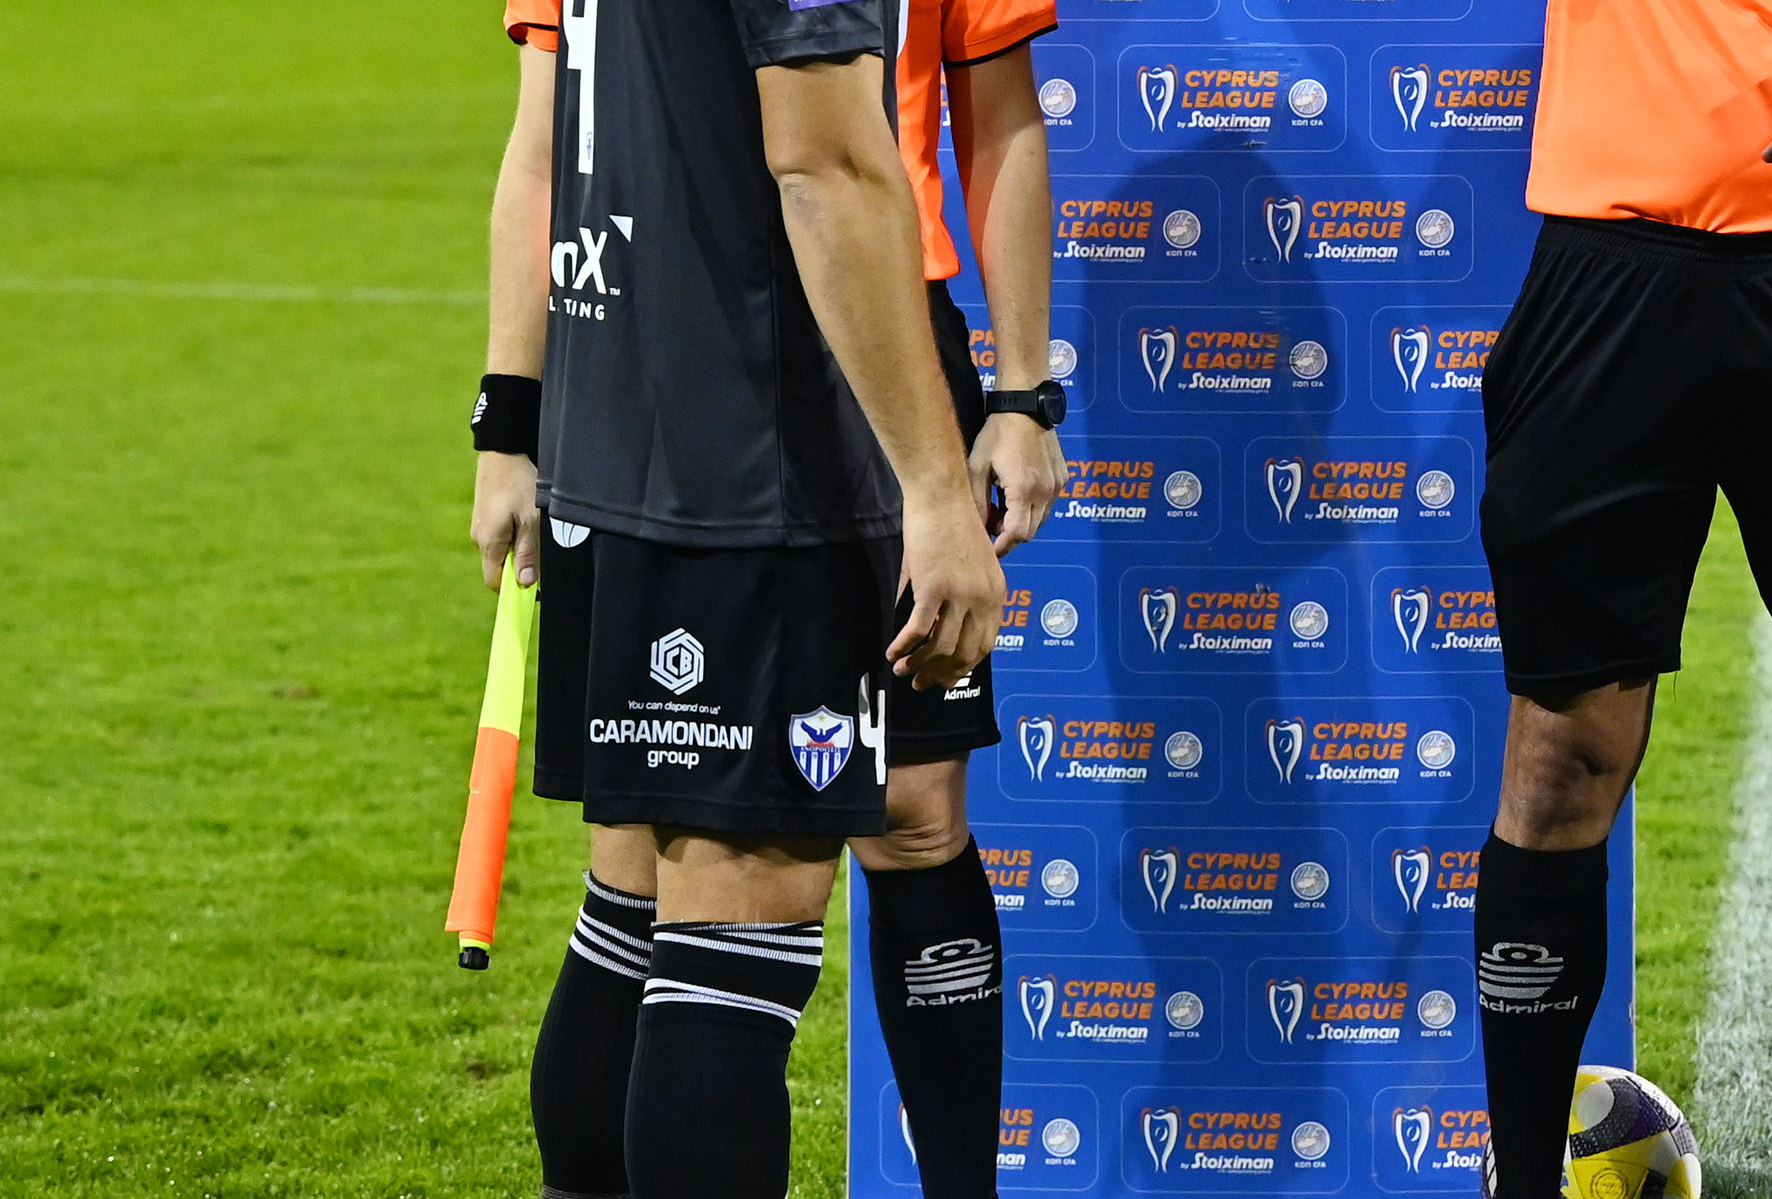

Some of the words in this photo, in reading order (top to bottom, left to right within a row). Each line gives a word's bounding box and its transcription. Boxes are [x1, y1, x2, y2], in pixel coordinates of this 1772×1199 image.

[1186, 71, 1278, 87] CYPRUS
[1439, 70, 1532, 86] CYPRUS
[1182, 91, 1276, 107] LEAGUE
[1436, 91, 1528, 107] LEAGUE
[1187, 111, 1271, 128] Stoiximan
[1441, 111, 1523, 128] Stoiximan
[1062, 201, 1153, 217] CYPRUS
[1312, 201, 1406, 217] CYPRUS
[1058, 222, 1151, 238] LEAGUE
[1309, 222, 1403, 238] LEAGUE
[1063, 241, 1145, 258] Stoiximan
[1314, 242, 1398, 259] Stoiximan
[1187, 332, 1279, 348] CYPRUS
[1183, 353, 1276, 369] LEAGUE
[1188, 373, 1272, 390] Stoiximan
[1065, 461, 1154, 478] CYPRUS
[1314, 462, 1407, 478] CYPRUS
[1061, 482, 1152, 498] LEAGUE
[1310, 483, 1404, 499] LEAGUE
[1065, 501, 1147, 518] Stoiximan
[1315, 503, 1399, 520] Stoiximan
[1187, 593, 1280, 609] CYPRUS
[1184, 613, 1277, 630] LEAGUE
[1189, 633, 1273, 650] Stoiximan
[943, 685, 981, 701] Admiral
[628, 700, 643, 710] You
[646, 702, 662, 710] can
[665, 701, 697, 713] depend
[699, 705, 709, 714] on
[590, 719, 753, 750] CARAMONDANI
[857, 671, 887, 786] 4
[1064, 721, 1155, 738] CYPRUS
[1314, 723, 1407, 739] CYPRUS
[1061, 742, 1152, 759] LEAGUE
[1311, 743, 1405, 760] LEAGUE
[647, 750, 700, 770] group
[1066, 761, 1147, 779] Stoiximan
[1316, 764, 1400, 782] Stoiximan
[1188, 853, 1280, 869] CYPRUS
[1185, 874, 1278, 890] LEAGUE
[1190, 893, 1273, 910] Stoiximan
[1065, 981, 1156, 998] CYPRUS
[1315, 983, 1408, 999] CYPRUS
[1062, 1001, 1153, 1019] LEAGUE
[1312, 1003, 1405, 1020] LEAGUE
[1479, 994, 1579, 1015] Admiral
[1066, 1021, 1149, 1039] Stoiximan
[1317, 1024, 1401, 1042] Stoiximan
[1189, 1113, 1281, 1129] CYPRUS
[1186, 1133, 1278, 1149] LEAGUE
[1191, 1153, 1274, 1171] Stoiximan
